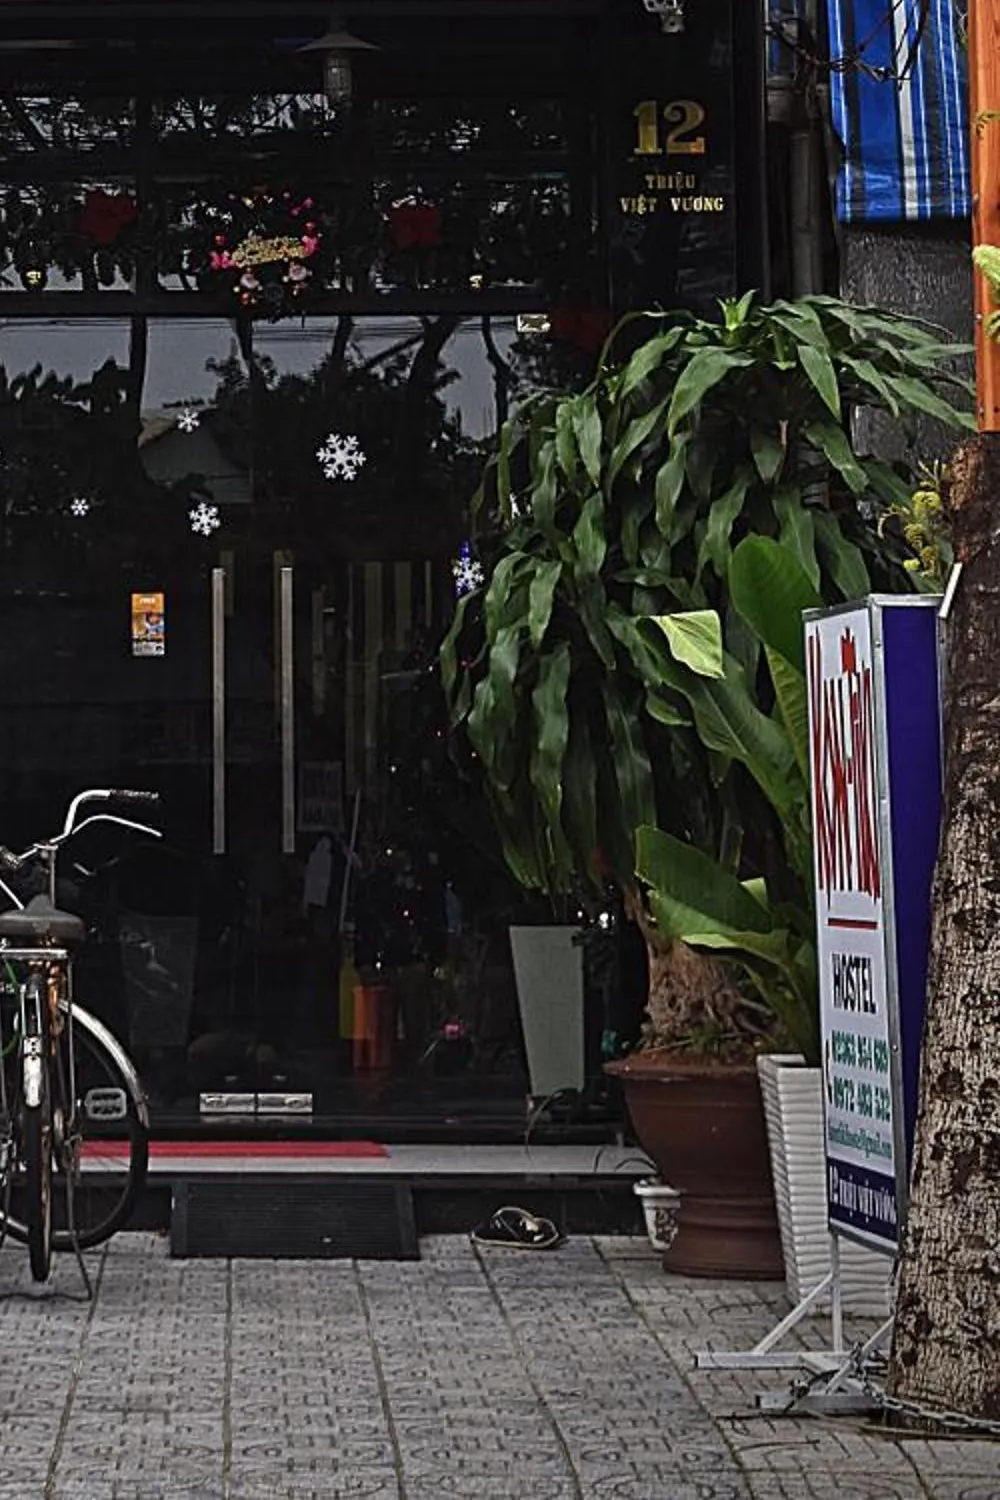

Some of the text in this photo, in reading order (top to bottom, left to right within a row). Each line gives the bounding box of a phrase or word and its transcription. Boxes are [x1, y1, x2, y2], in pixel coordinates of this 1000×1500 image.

[632, 100, 705, 155] 12
[620, 194, 724, 215] VIỆT VƯƠNG
[832, 954, 876, 1014] HOSTEL
